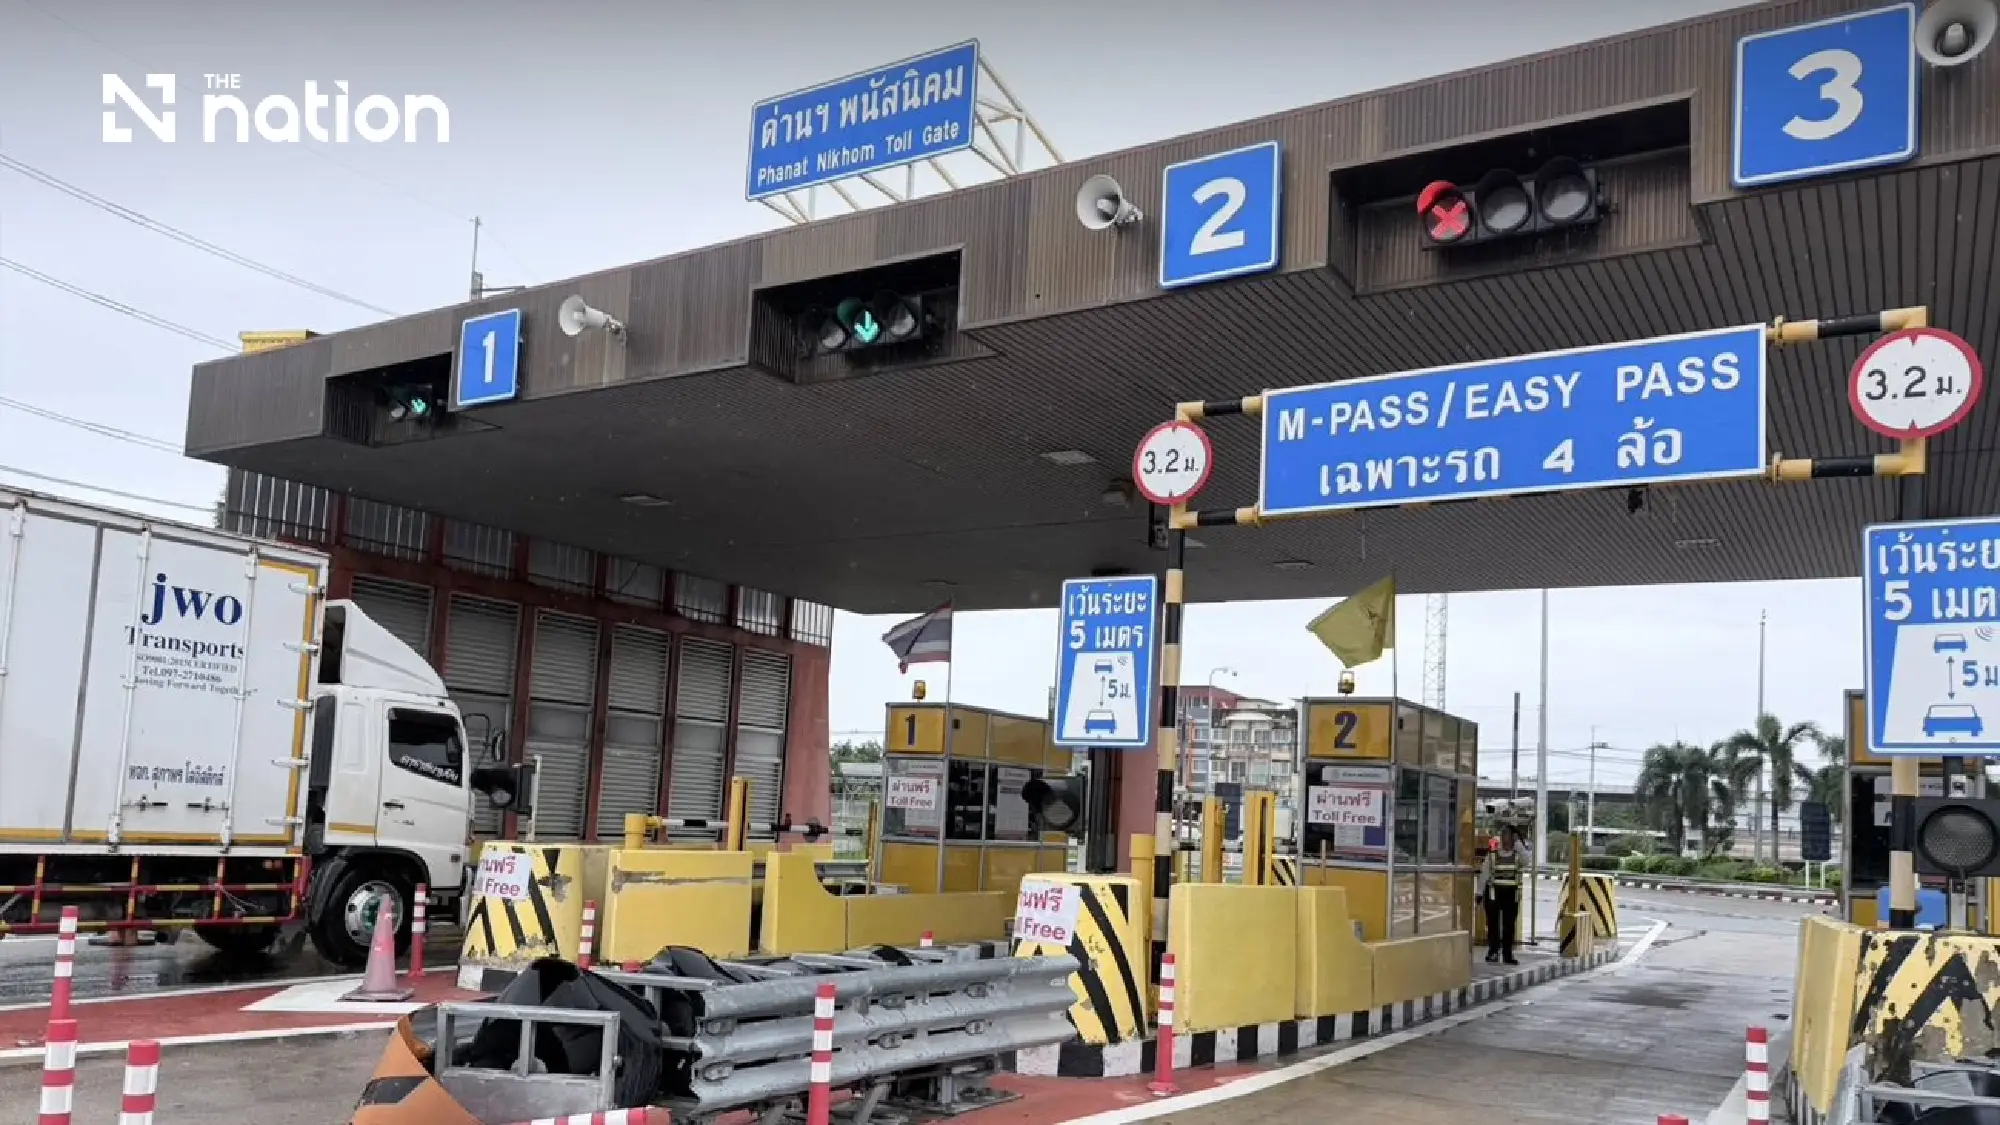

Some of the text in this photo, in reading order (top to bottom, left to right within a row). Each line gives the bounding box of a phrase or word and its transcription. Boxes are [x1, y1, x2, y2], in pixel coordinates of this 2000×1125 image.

[761, 65, 964, 149] ด่านฯ พนัสนิคม
[1782, 48, 1863, 140] 3
[757, 120, 960, 187] Phanat Nikhom Toll Gate
[1189, 177, 1246, 255] 2
[482, 331, 496, 383] 1
[1278, 351, 1741, 442] M-PASS/EASY PASS
[1865, 365, 1963, 401] 3.2 ม.
[1142, 448, 1199, 475] 3.2 ม.
[1319, 415, 1683, 497] เฉพาะรถ 4 ล้อ
[1877, 531, 2000, 576] เว้นระย
[141, 573, 243, 626] jwo
[1068, 584, 1148, 617] เว้นระยะ
[1884, 579, 1998, 621] 5 เมต
[124, 625, 244, 660] Transports
[1069, 619, 1144, 650] 5 เมตร
[1984, 665, 2000, 687] ม
[905, 713, 916, 746] 1
[1334, 710, 1358, 749] 2
[889, 795, 933, 807] Toll Free
[1312, 809, 1376, 824] Toll Free
[1316, 789, 1372, 808] ผ่านฟรี
[485, 878, 521, 897] Free
[1024, 917, 1066, 940] Free
